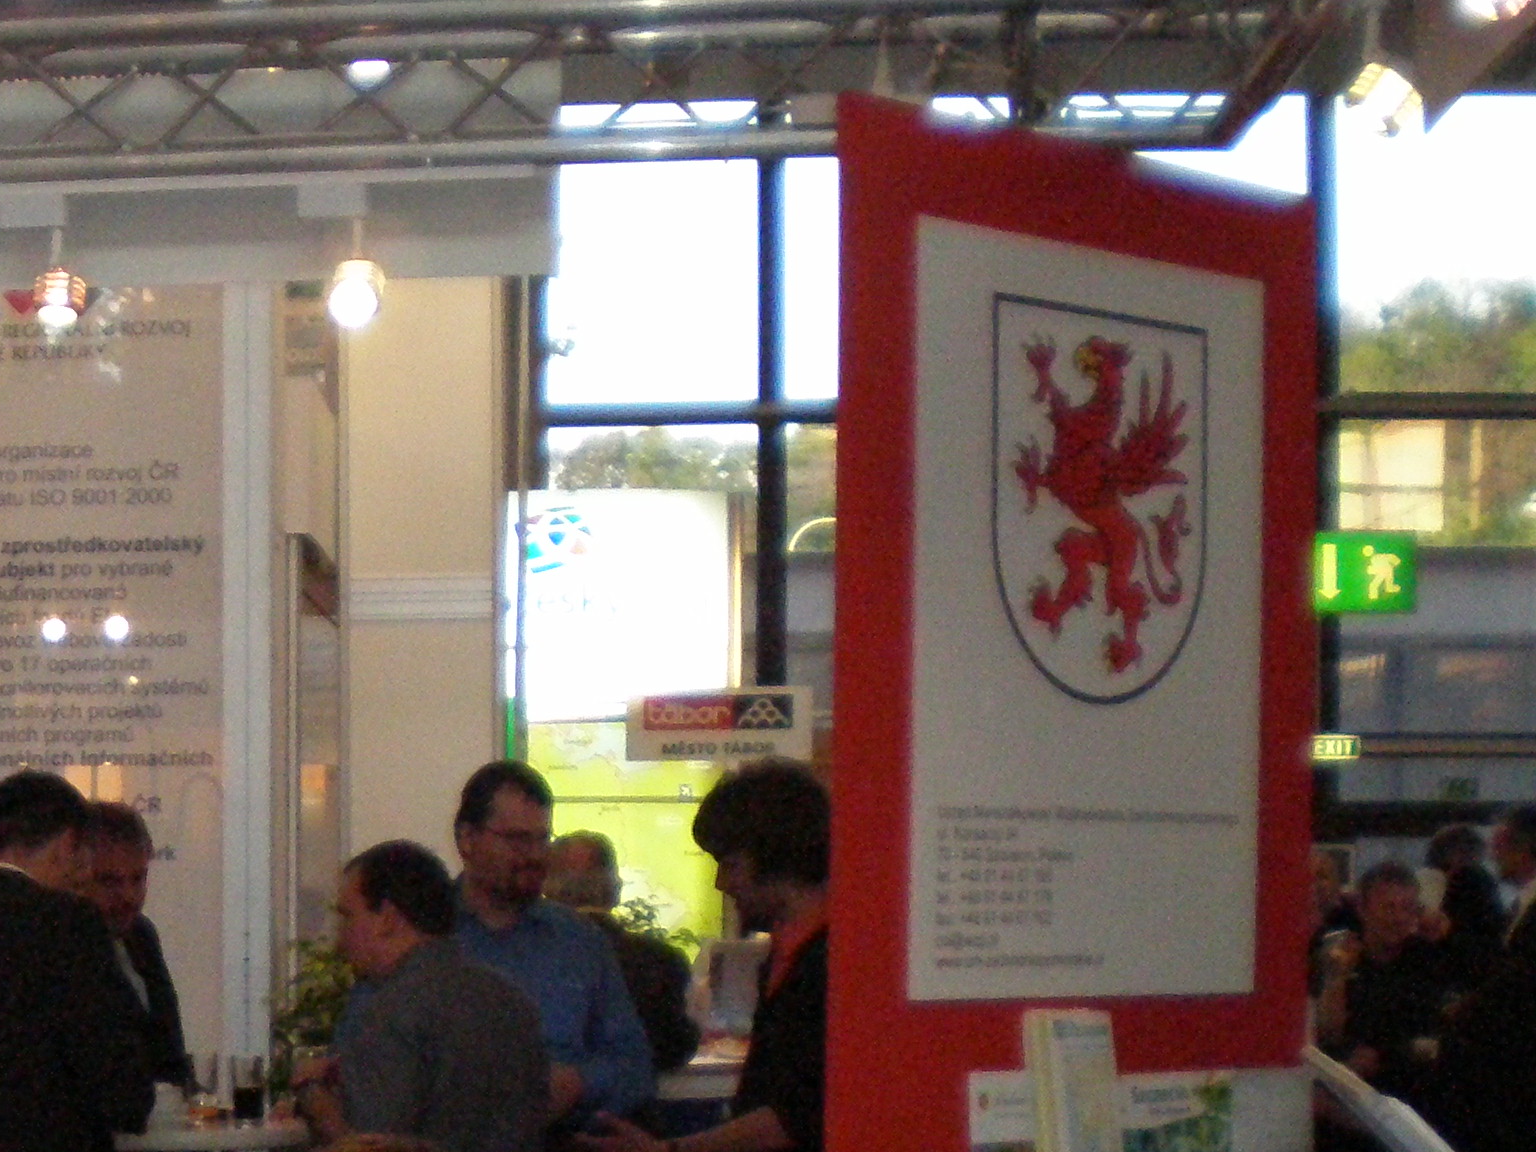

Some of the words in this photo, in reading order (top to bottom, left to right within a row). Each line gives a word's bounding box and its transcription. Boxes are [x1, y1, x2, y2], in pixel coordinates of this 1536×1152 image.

[86, 464, 143, 483] rozvoj
[148, 458, 179, 481] ČR
[30, 486, 66, 506] ISO
[61, 563, 92, 581] pro
[1314, 739, 1355, 756] EXIT
